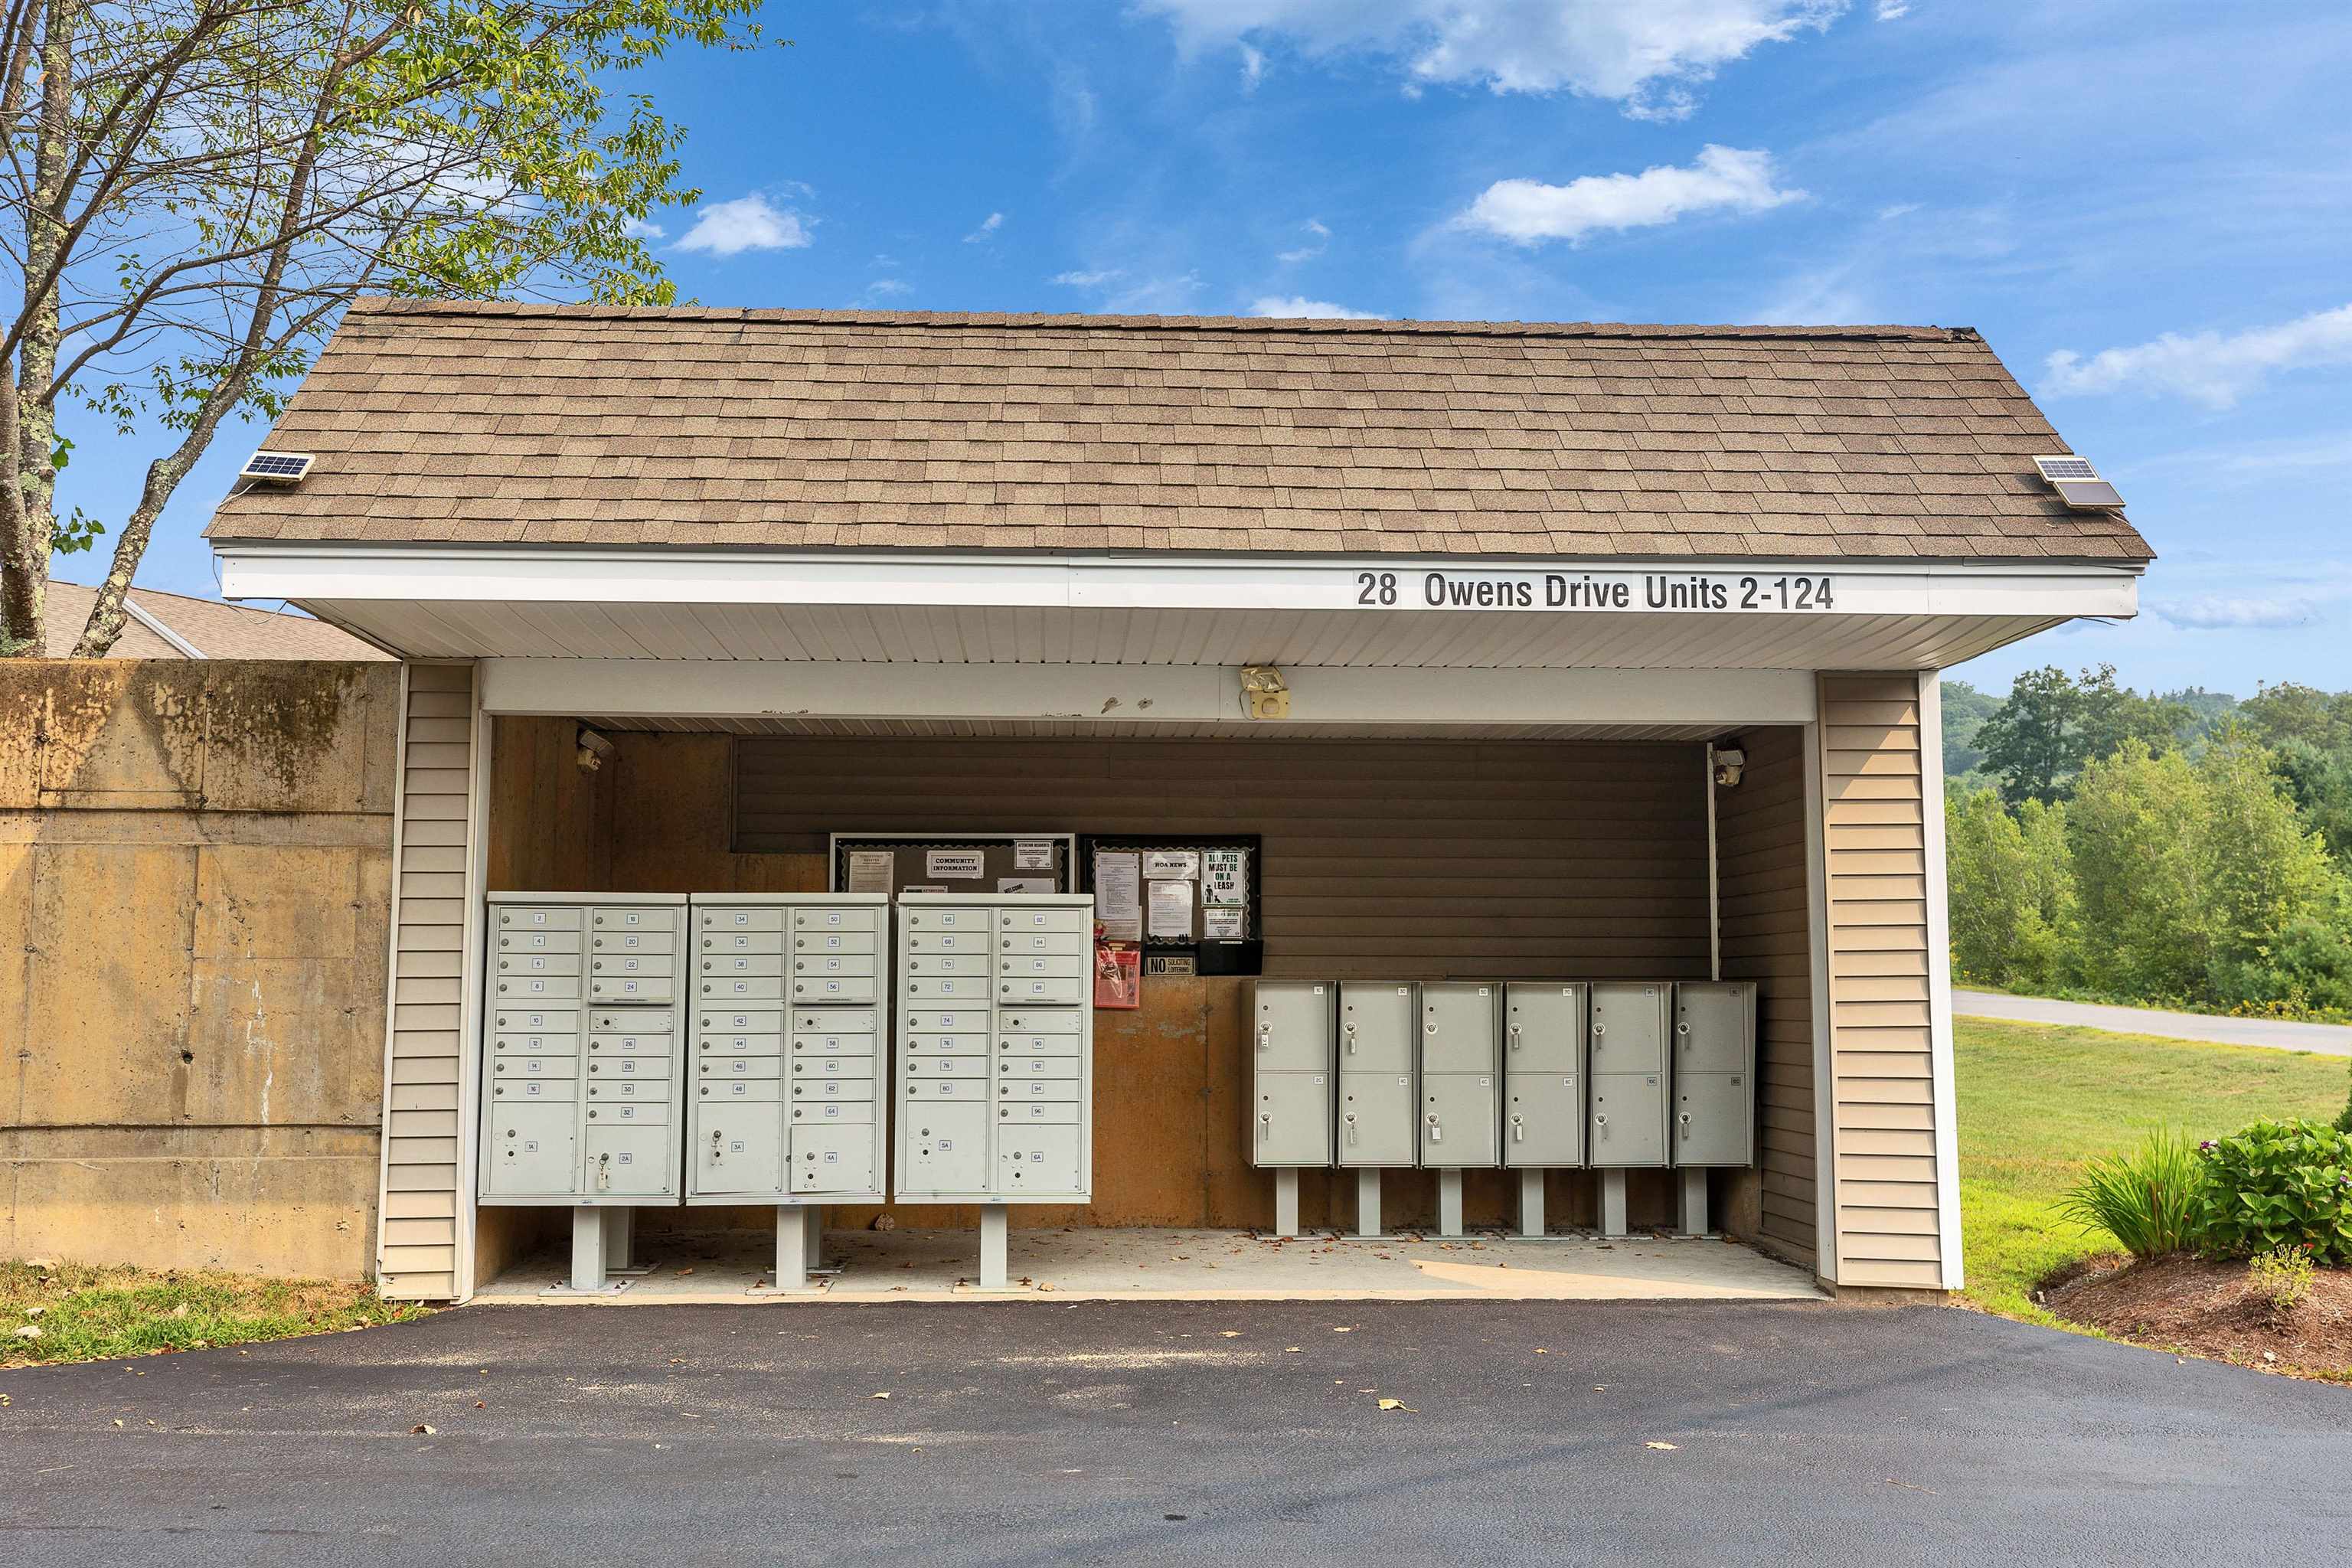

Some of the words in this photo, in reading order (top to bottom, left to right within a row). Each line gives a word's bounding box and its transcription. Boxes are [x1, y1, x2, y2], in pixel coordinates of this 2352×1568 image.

[1357, 573, 1396, 606] 28
[1425, 573, 1532, 606] Owens
[1545, 574, 1629, 608] Drive
[1645, 576, 1727, 609] Units
[1740, 577, 1834, 609] 2-124
[1222, 854, 1238, 862] PETS
[1208, 863, 1227, 871] MUST
[1215, 872, 1224, 880] ON
[1227, 872, 1231, 880] A
[1214, 882, 1234, 890] LEASH
[1151, 958, 1166, 973] NO
